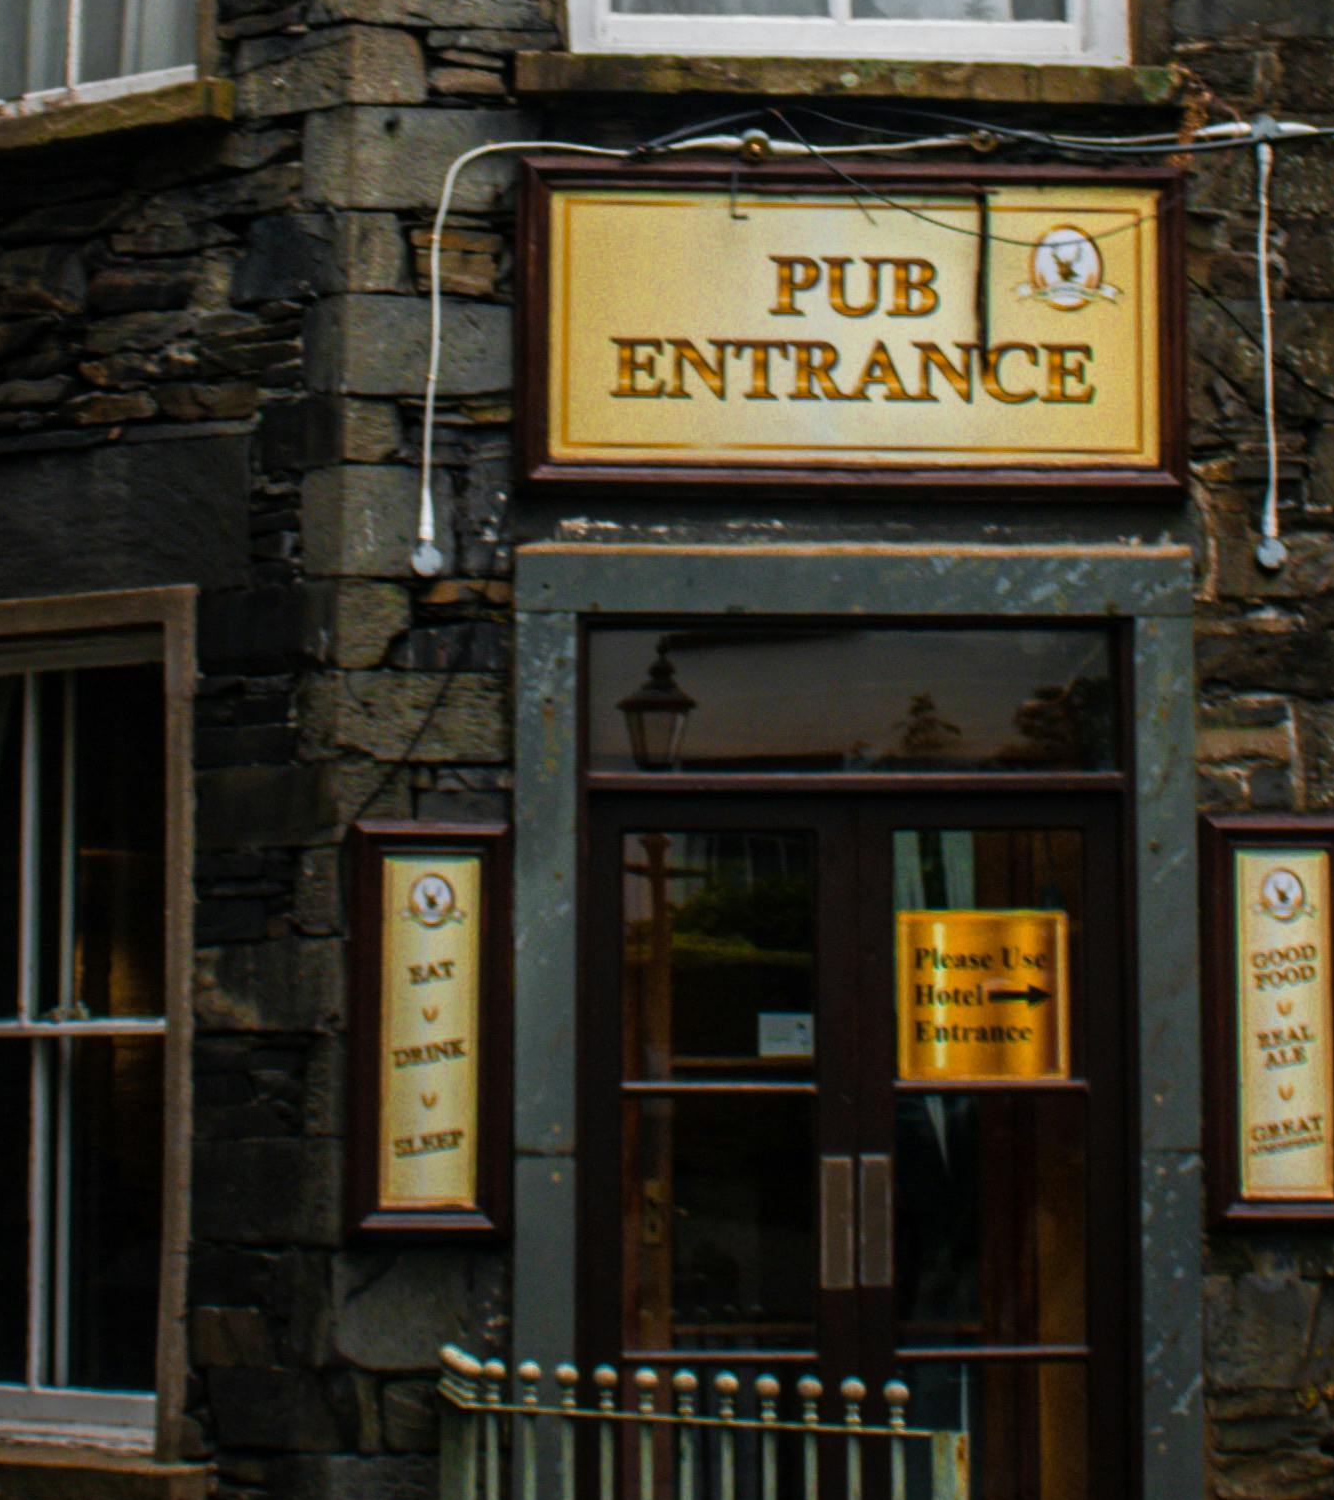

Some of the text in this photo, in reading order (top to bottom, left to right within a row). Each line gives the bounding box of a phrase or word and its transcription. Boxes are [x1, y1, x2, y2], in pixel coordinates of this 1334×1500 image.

[767, 254, 940, 319] PUB
[608, 335, 1097, 405] ENTRANCE
[914, 946, 1050, 971] Please Use
[1250, 943, 1318, 971] GOOD
[407, 960, 456, 986] EAT
[1253, 962, 1317, 992] FOOD
[914, 983, 985, 1007] Hotel
[914, 1019, 1034, 1045] Entrance
[1257, 1024, 1315, 1051] REAL
[392, 1039, 467, 1069] DRINK
[1265, 1044, 1308, 1069] ALE
[1250, 1113, 1325, 1144] GREAT
[393, 1129, 465, 1159] SLEEP
